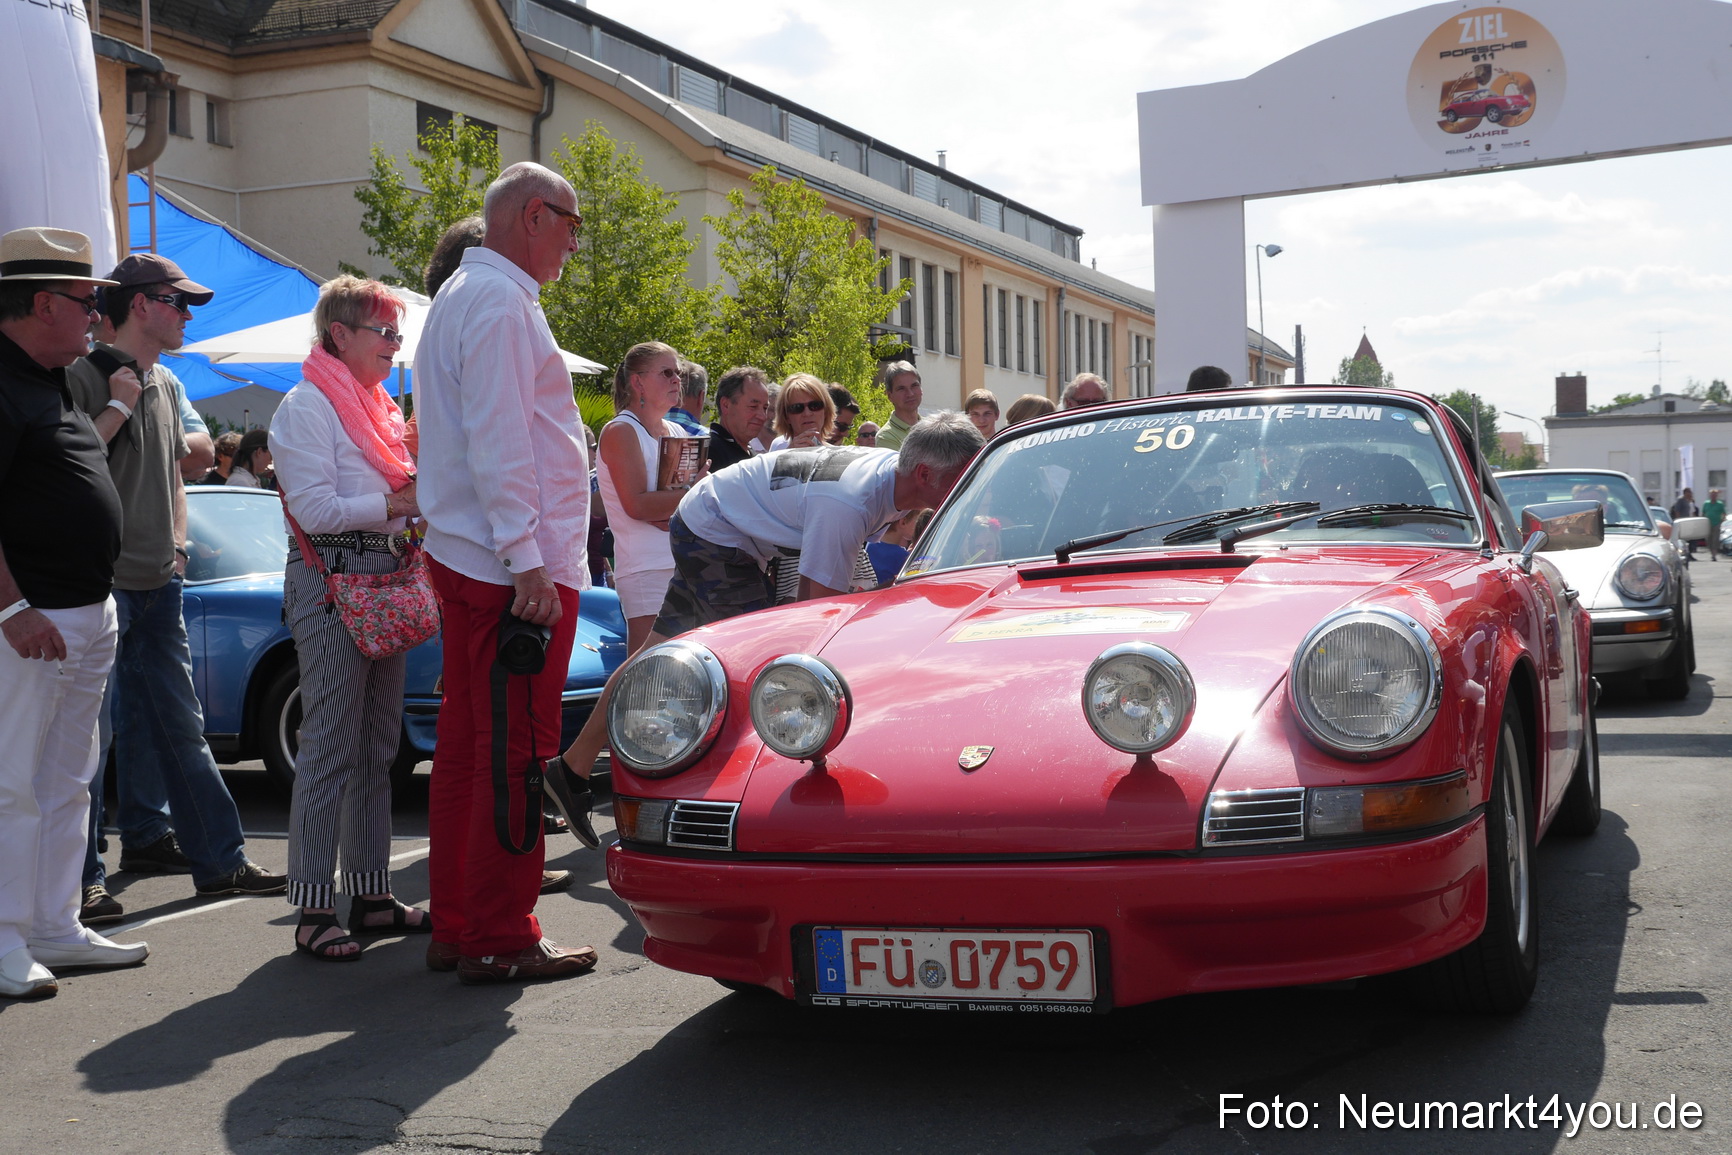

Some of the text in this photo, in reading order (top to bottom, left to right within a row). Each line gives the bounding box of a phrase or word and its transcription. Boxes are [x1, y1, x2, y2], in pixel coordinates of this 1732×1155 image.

[1458, 13, 1509, 44] ZIEL
[1439, 40, 1528, 60] PORSCHE
[1471, 52, 1495, 62] 911
[1436, 71, 1537, 135] 50
[1464, 128, 1509, 139] JAHRE
[1097, 413, 1191, 435] Historic
[1195, 404, 1382, 423] RALLYE-TEAM
[1133, 424, 1196, 453] 50
[827, 967, 837, 982] D
[851, 937, 916, 988] FÜ
[949, 938, 1079, 991] 0759
[812, 996, 841, 1006] CG
[846, 1000, 959, 1010] SPORTWAGEN
[1019, 1004, 1092, 1014] 0951-9684940
